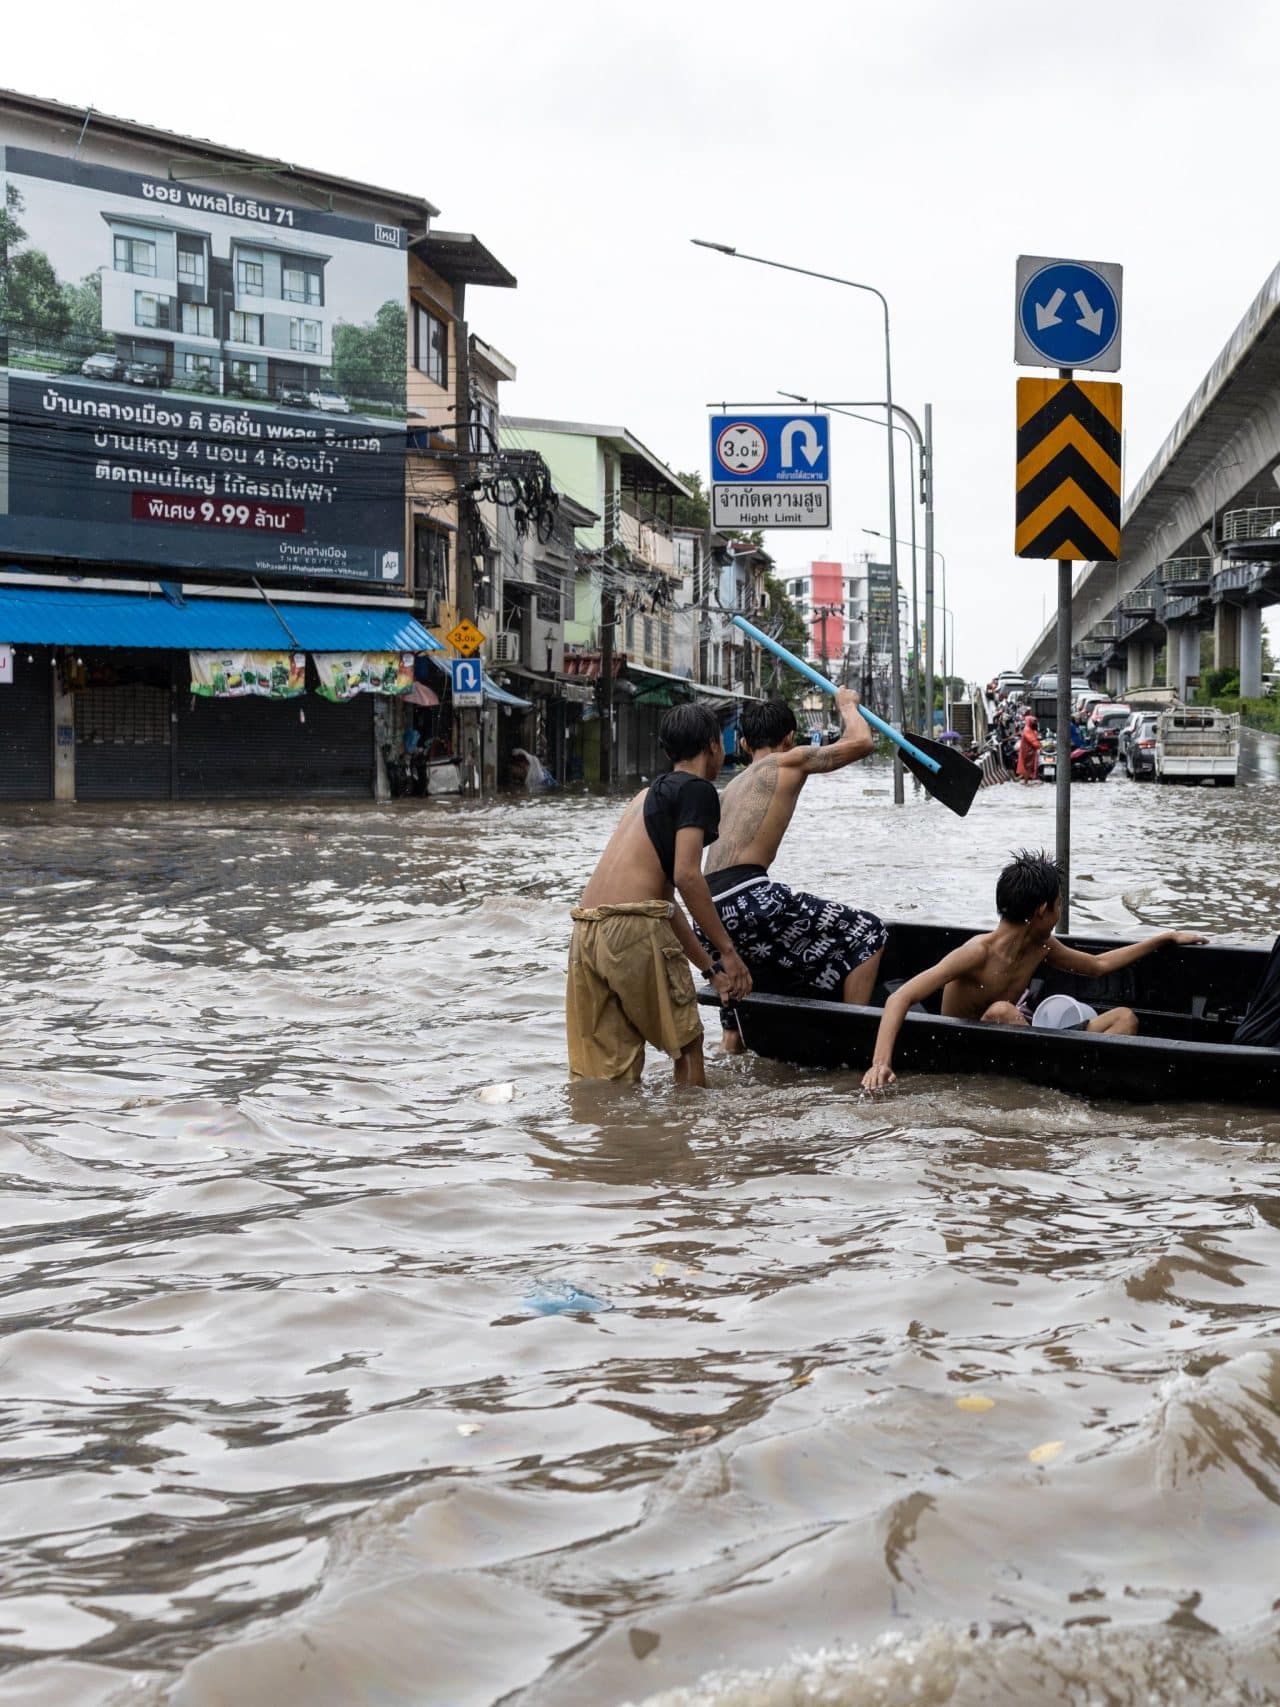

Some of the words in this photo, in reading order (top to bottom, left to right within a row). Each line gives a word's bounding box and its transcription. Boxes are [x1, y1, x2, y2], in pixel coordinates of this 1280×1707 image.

[142, 182, 182, 202] ซอย
[187, 192, 270, 222] พหลโยธิน
[275, 208, 294, 226] 71
[42, 389, 183, 427] บ้านกลางเมือง
[189, 411, 203, 430] ดิ
[208, 411, 261, 436] อิดิชั่น
[186, 441, 199, 459] 4
[206, 444, 247, 463] นอน
[253, 449, 266, 466] 4
[724, 440, 749, 457] 3.0
[95, 459, 216, 495] ติดถนนใหญ่
[148, 499, 196, 520] พิเศษ
[200, 502, 250, 525] 9.99
[720, 488, 822, 513] จำกัดความสูง
[740, 513, 769, 524] Hight
[775, 513, 802, 522] Limit
[279, 542, 347, 558] บ้านกลางเมือง
